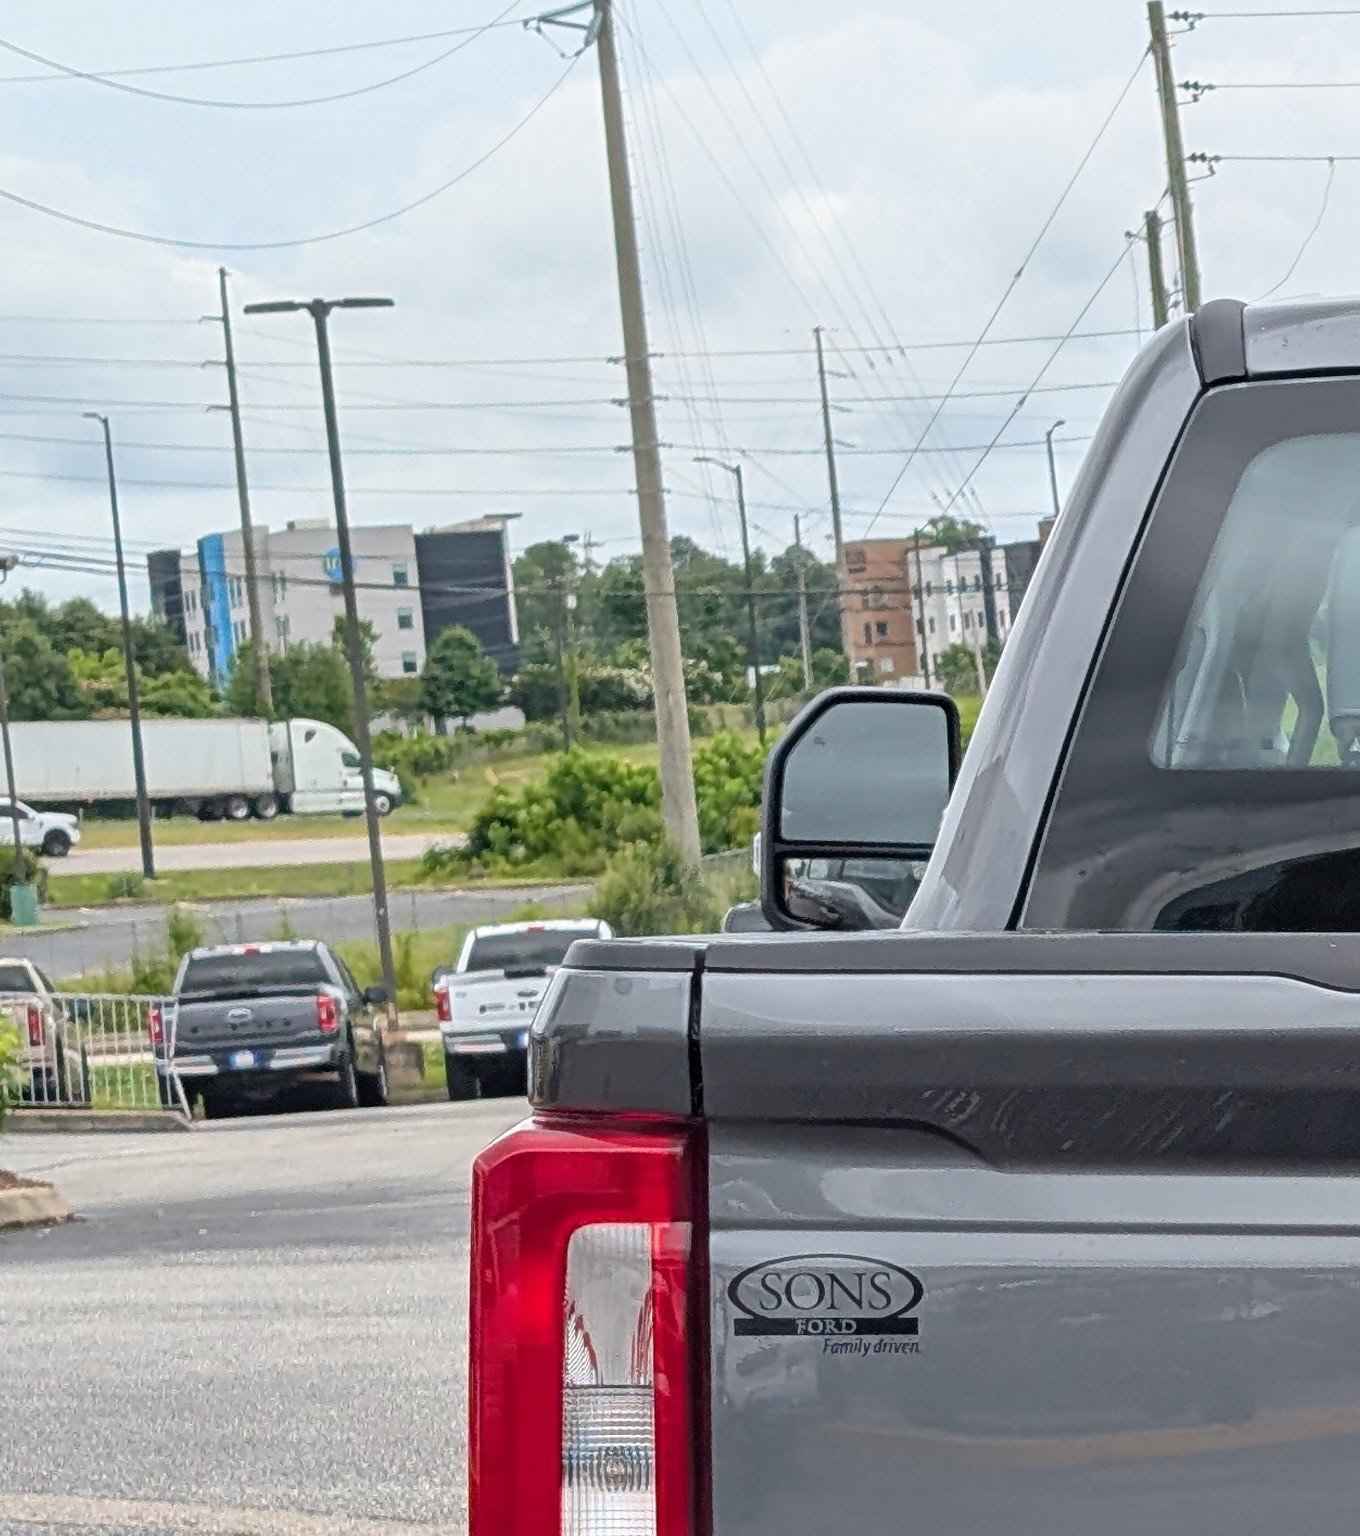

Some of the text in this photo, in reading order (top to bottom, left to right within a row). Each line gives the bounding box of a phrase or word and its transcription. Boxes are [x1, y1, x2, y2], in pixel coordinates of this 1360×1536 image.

[758, 1271, 893, 1311] SONS
[796, 1318, 858, 1335] FORD
[822, 1337, 920, 1357] Family driven
